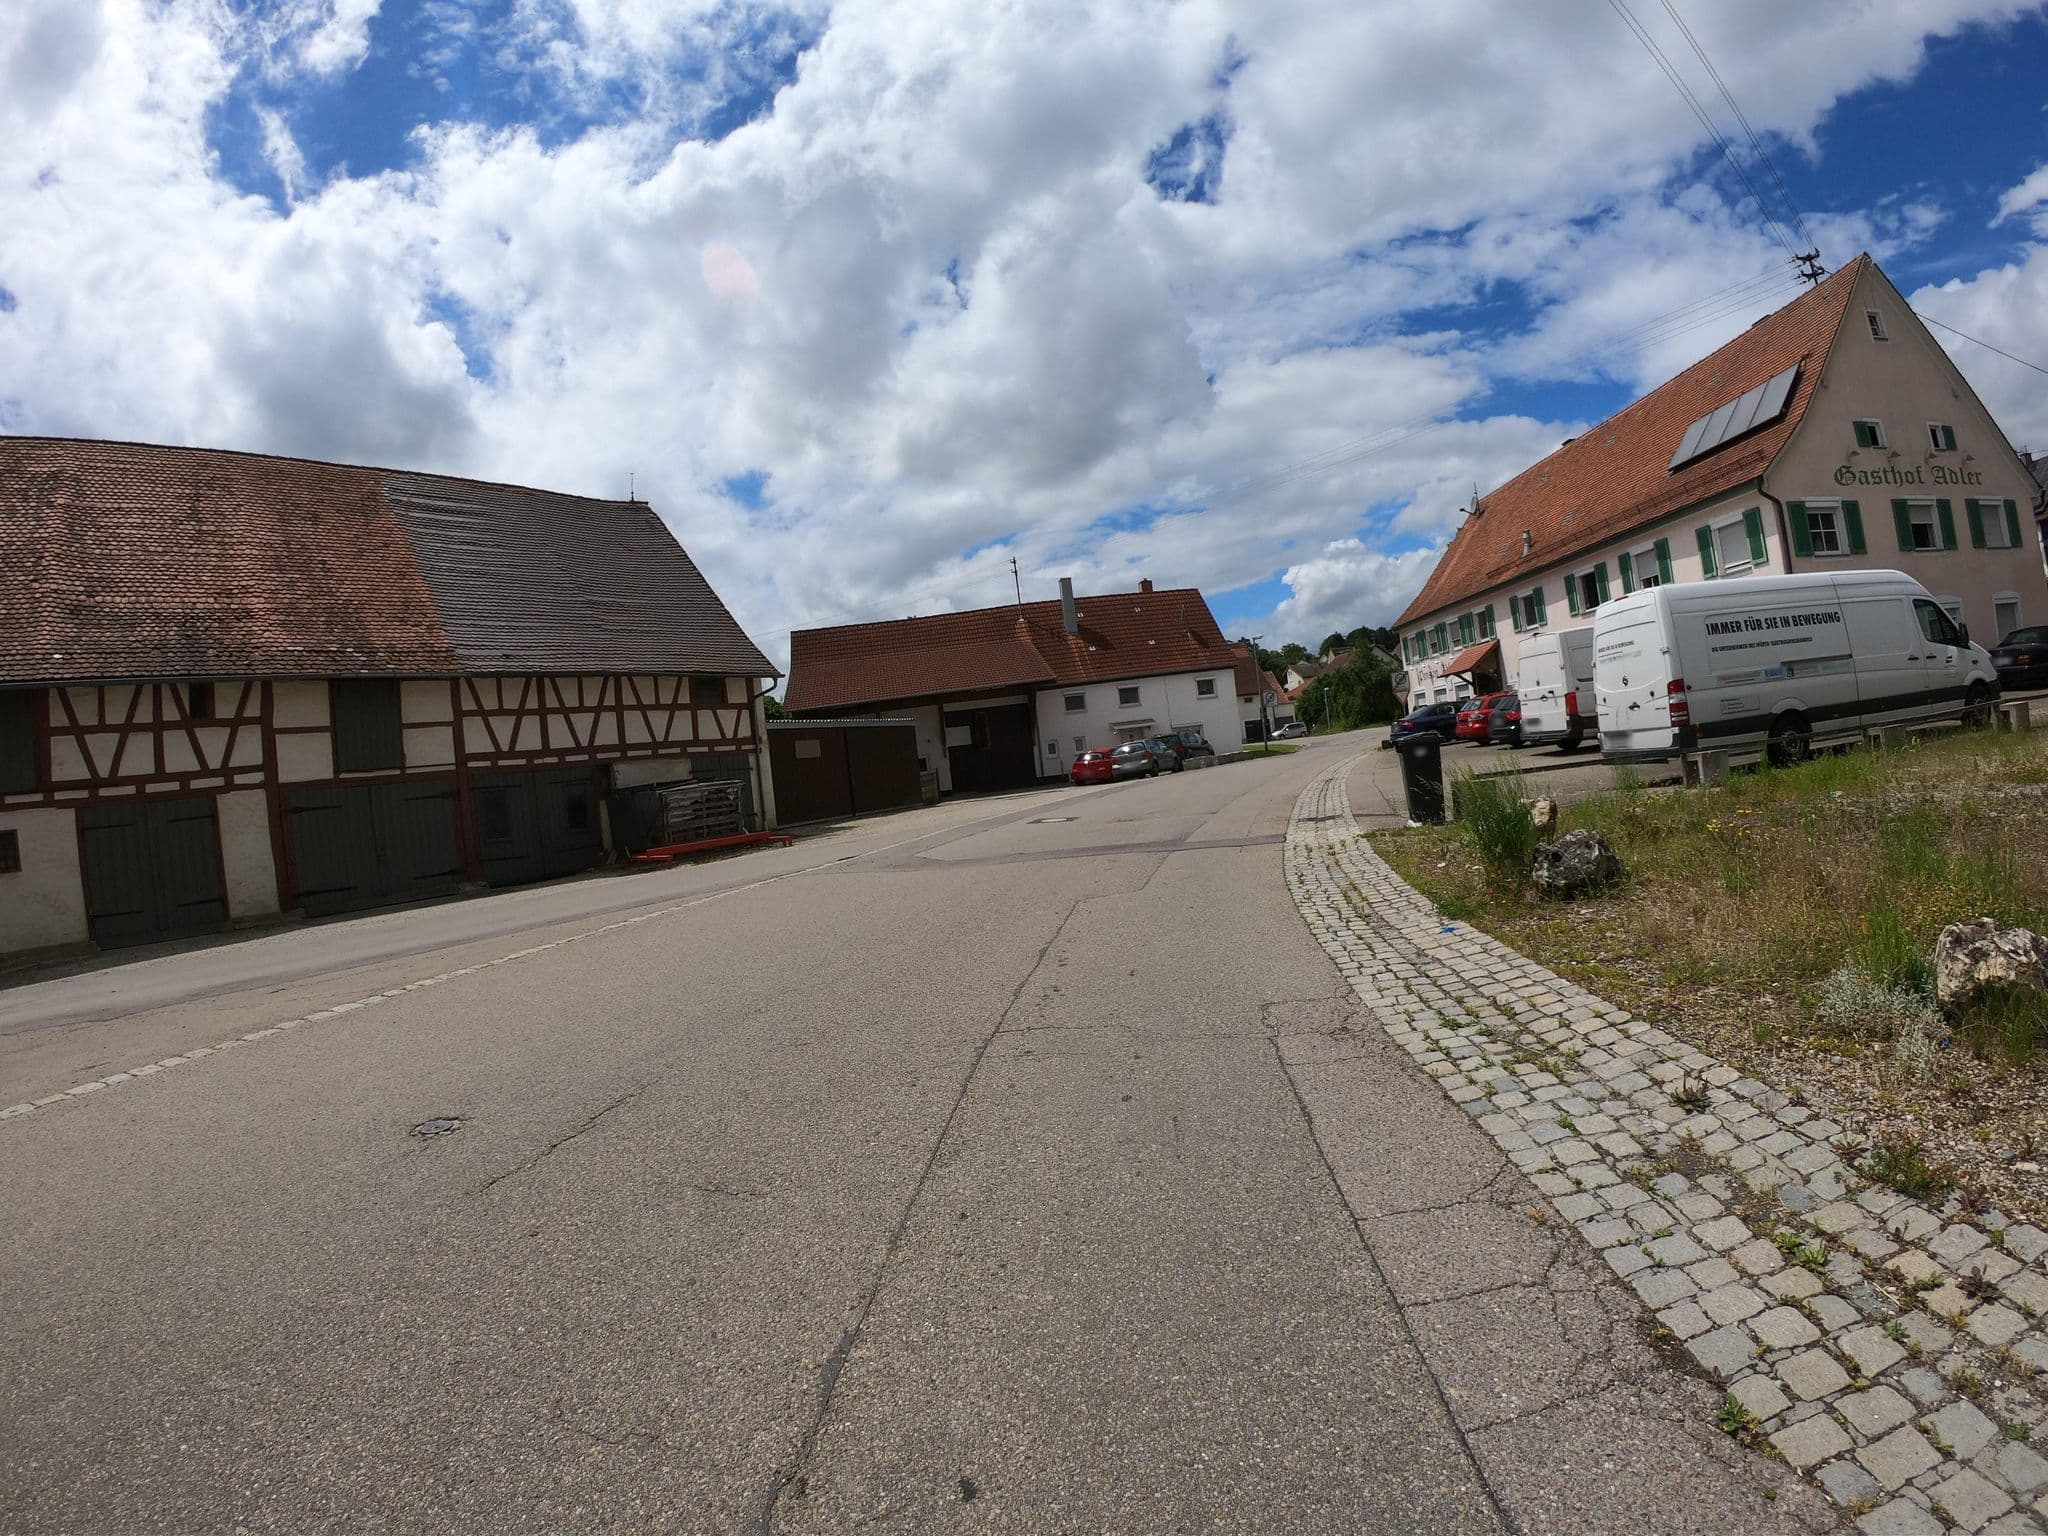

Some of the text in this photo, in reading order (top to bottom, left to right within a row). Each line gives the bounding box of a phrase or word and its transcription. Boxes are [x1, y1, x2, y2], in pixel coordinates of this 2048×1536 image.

[1834, 465, 1983, 488] Gasthof Adler
[1706, 611, 1841, 636] IMMER FÜR SIE IN BEWEGUNG
